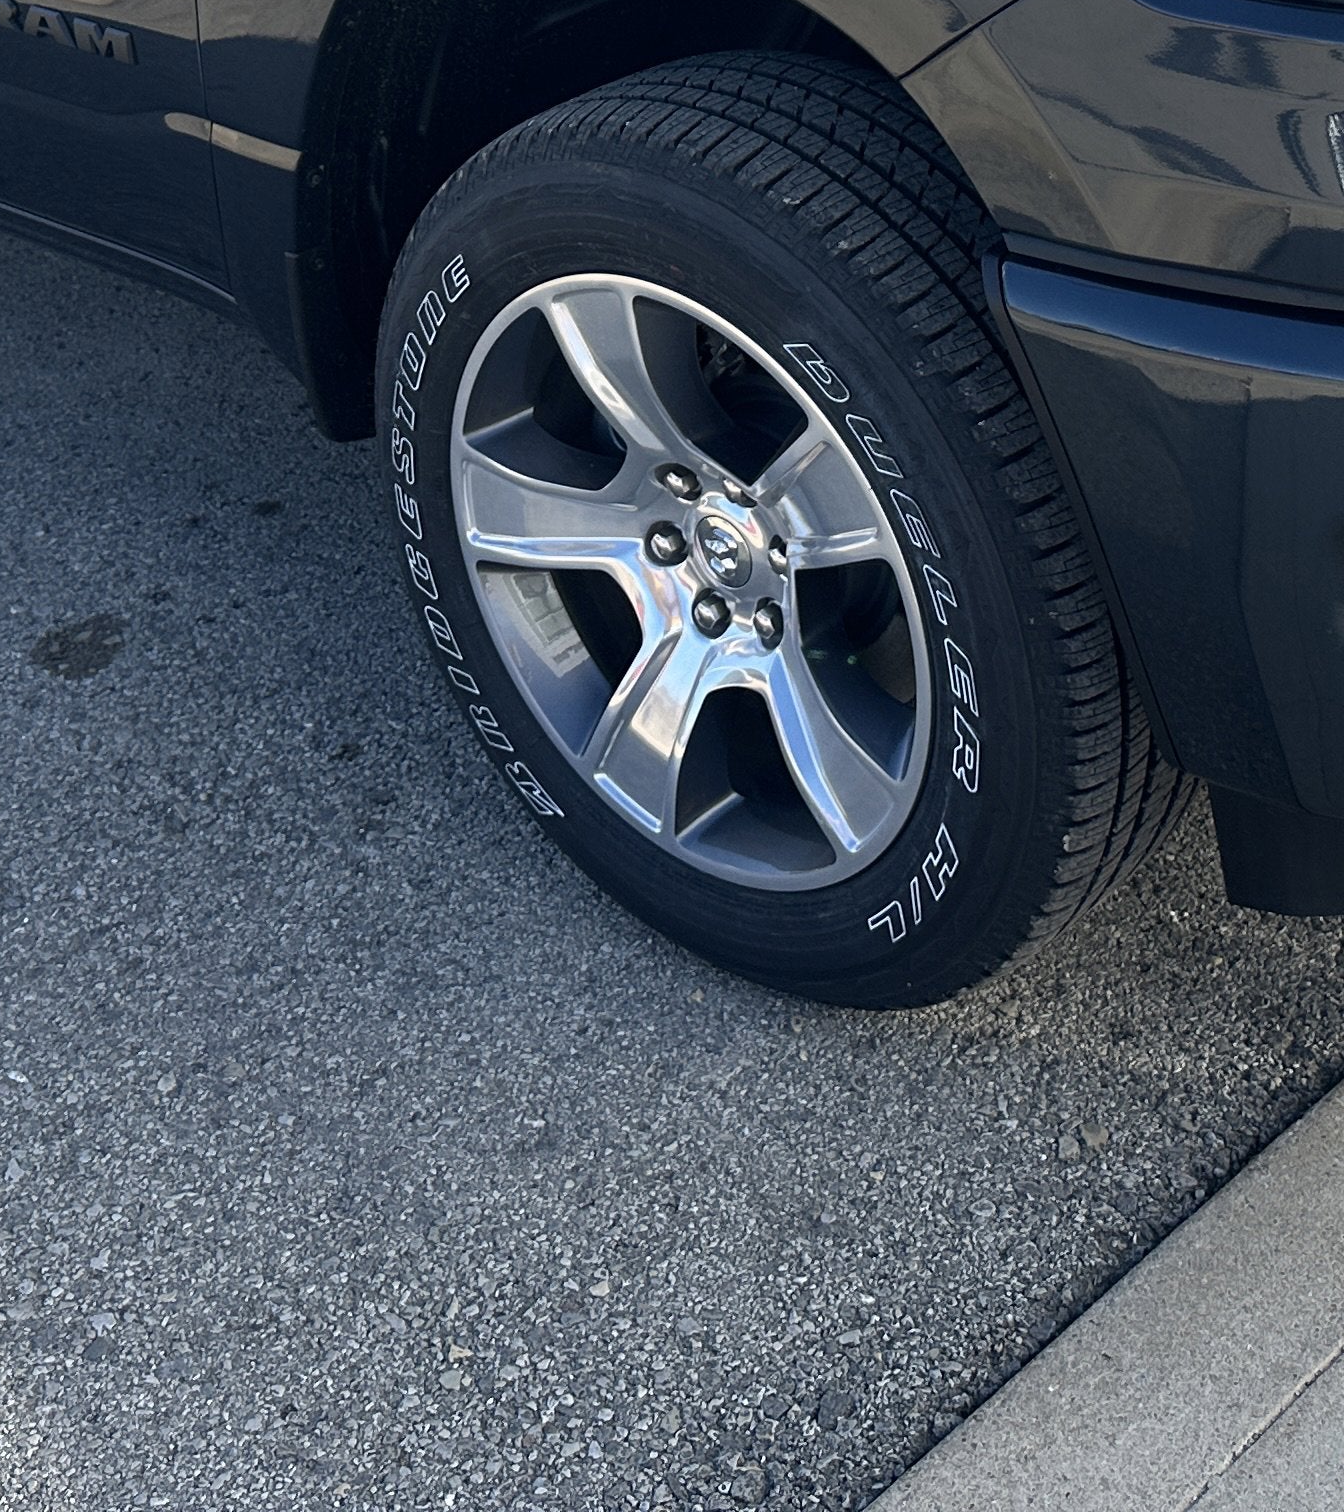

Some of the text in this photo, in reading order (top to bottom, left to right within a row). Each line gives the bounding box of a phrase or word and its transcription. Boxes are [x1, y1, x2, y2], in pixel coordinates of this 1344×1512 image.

[391, 252, 565, 819] BRIDGESTONE
[783, 342, 982, 945] DUELER H/L
